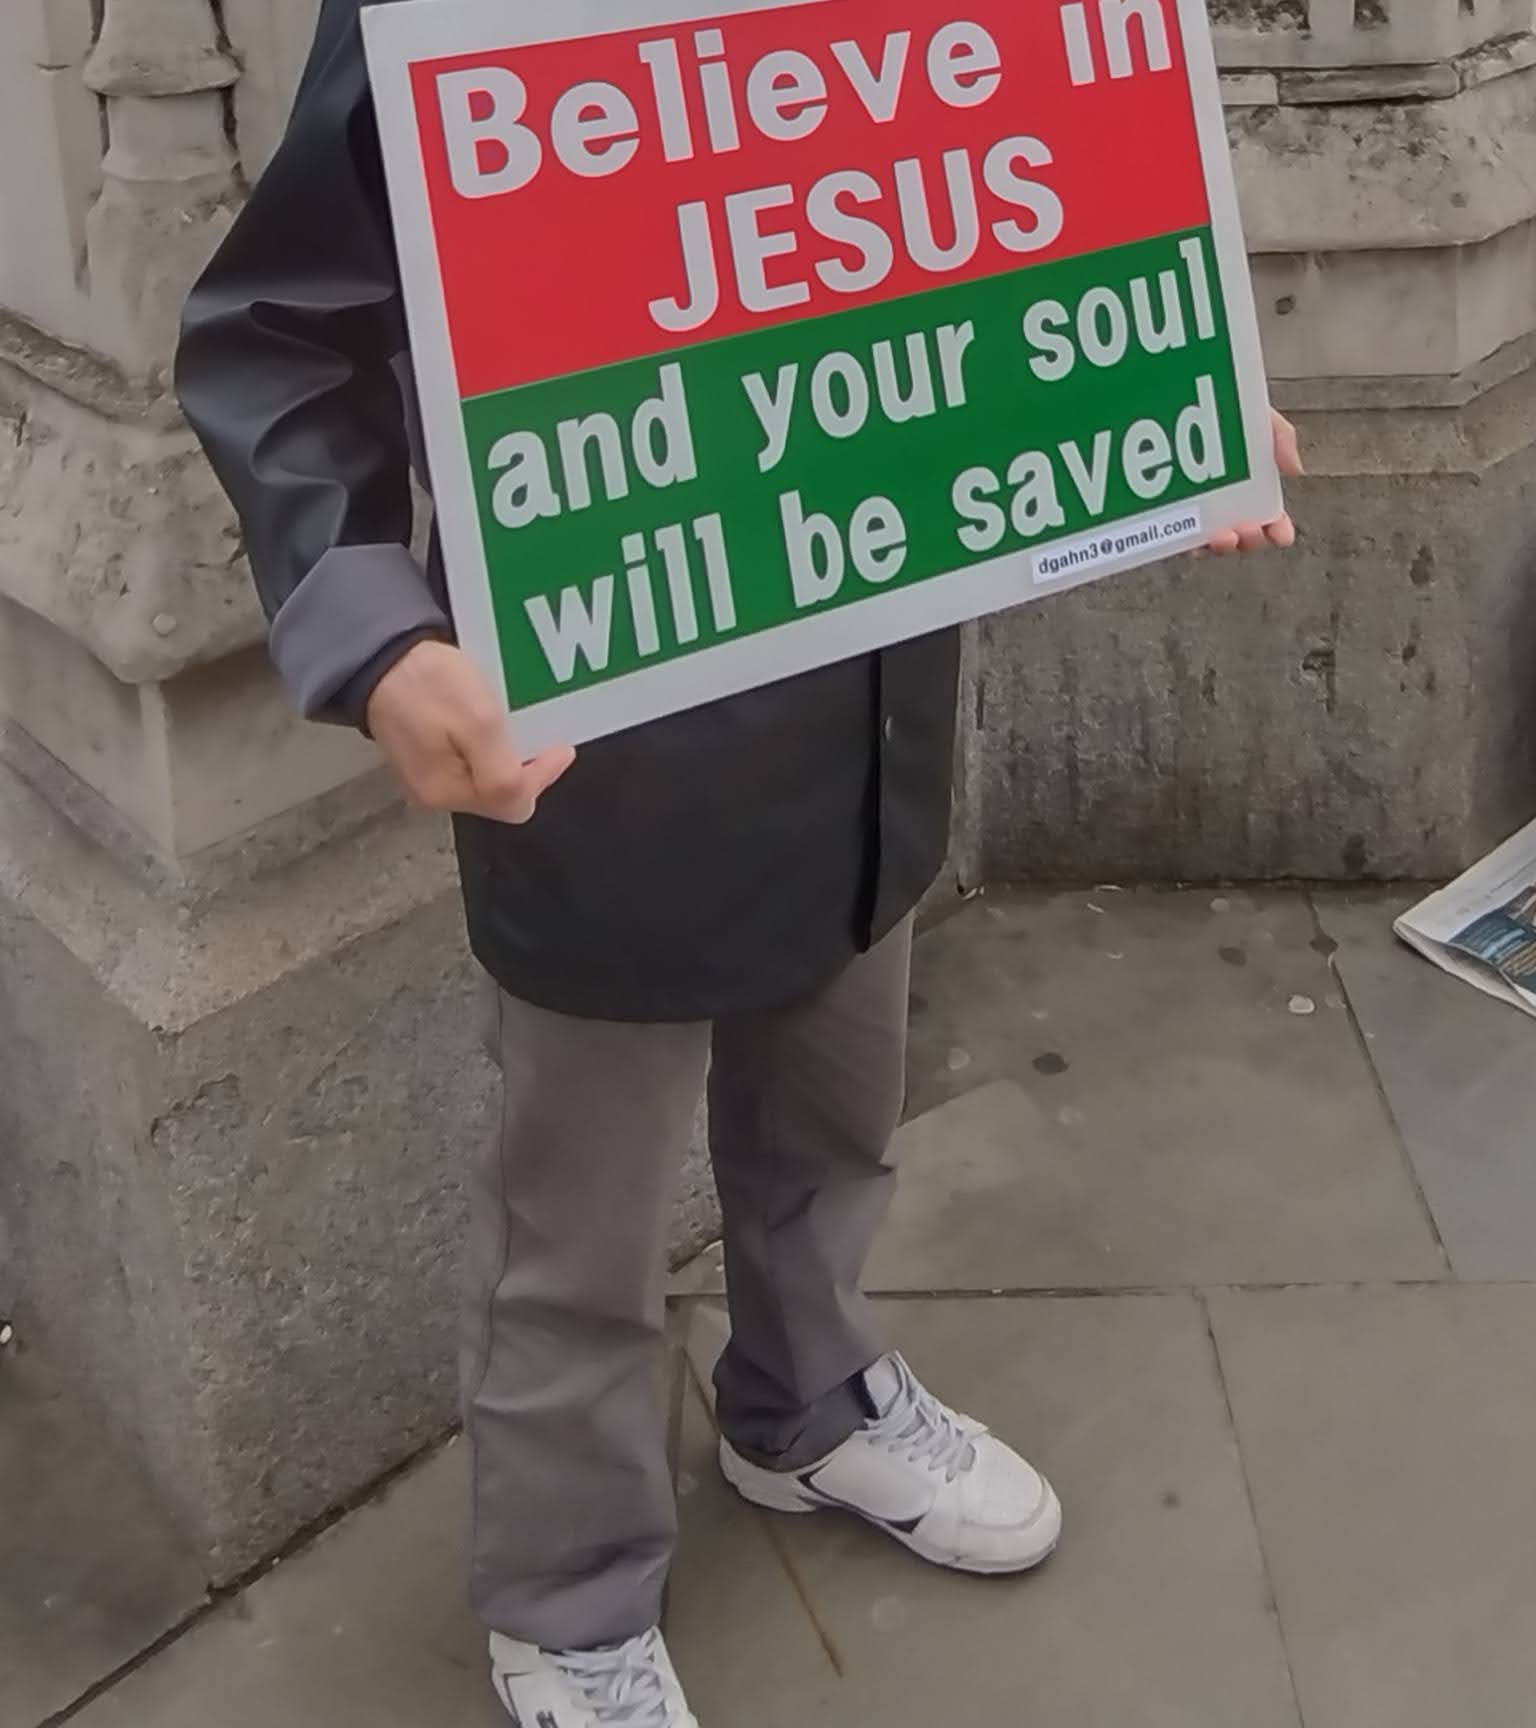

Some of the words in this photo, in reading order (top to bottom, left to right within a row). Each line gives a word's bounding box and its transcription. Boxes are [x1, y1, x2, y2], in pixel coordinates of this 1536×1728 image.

[434, 21, 1001, 198] Believe
[648, 135, 1065, 332] JESUS
[486, 364, 698, 529] and
[742, 319, 974, 472] your
[1022, 237, 1216, 382] soul
[525, 514, 737, 684] will
[780, 491, 907, 609] be
[952, 374, 1227, 550] saved
[1038, 516, 1196, 574] dgahn3@gmail.com
